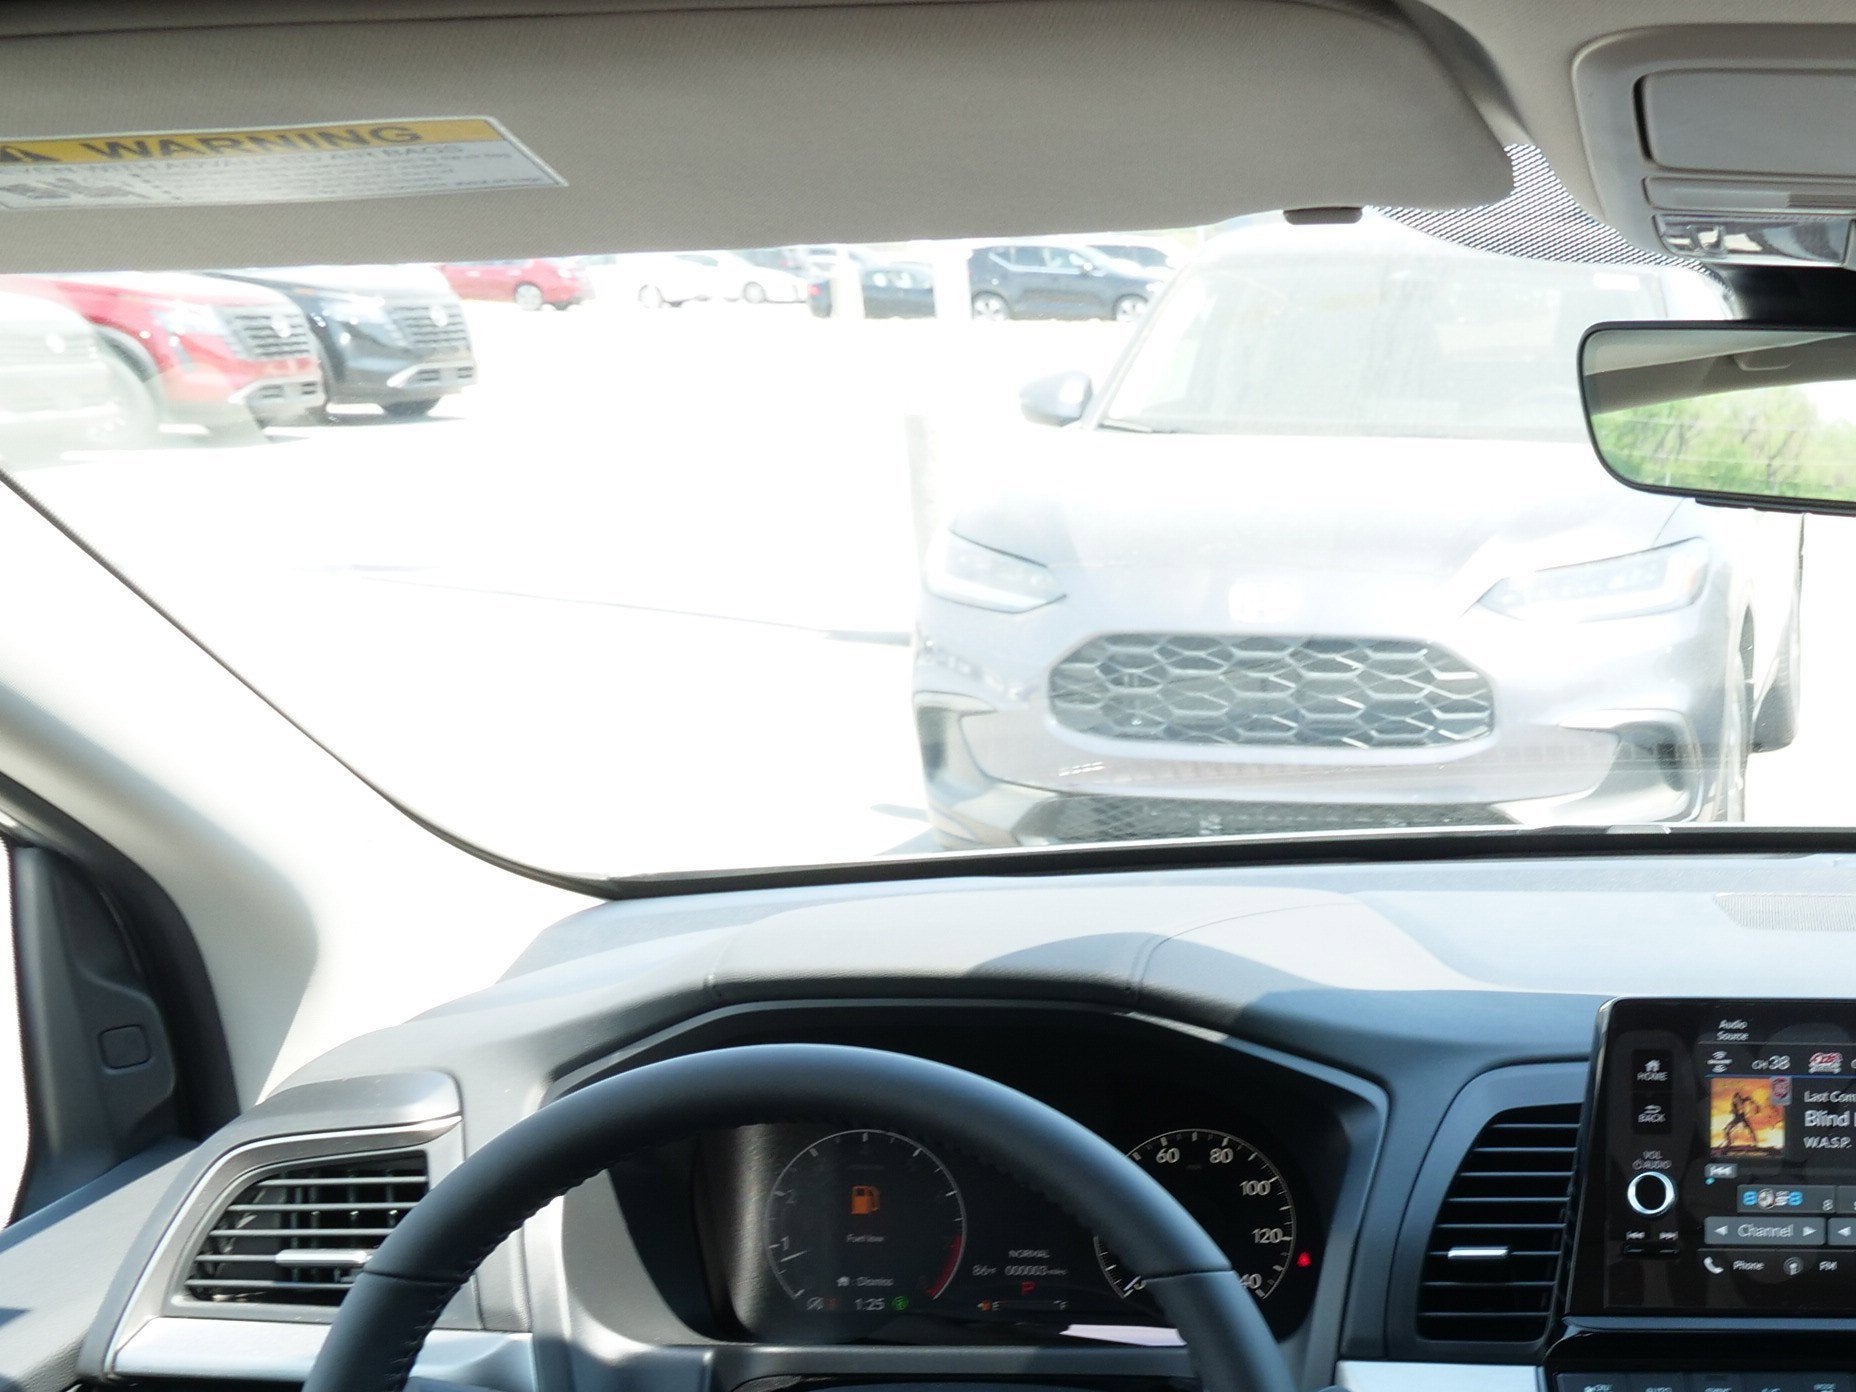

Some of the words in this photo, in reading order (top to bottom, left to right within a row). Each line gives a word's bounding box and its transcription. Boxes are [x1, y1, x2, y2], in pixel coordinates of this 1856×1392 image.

[79, 126, 422, 158] WARNING
[1718, 1019, 1748, 1030] Audio
[1716, 1031, 1749, 1041] Source
[1636, 1071, 1669, 1082] HOME
[1804, 1090, 1829, 1103] Last
[1637, 1112, 1667, 1123] BACK
[1804, 1109, 1850, 1127] Blind
[1156, 1147, 1181, 1163] 60
[1209, 1147, 1234, 1164] 80
[1239, 1180, 1271, 1196] 100
[1822, 1199, 1834, 1211] 8
[1251, 1227, 1284, 1244] 120
[1737, 1223, 1794, 1238] Channel
[1008, 1249, 1051, 1259] NORMAL
[1732, 1260, 1766, 1271] Phone
[1819, 1261, 1838, 1271] FM
[1020, 1280, 1038, 1296] P
[855, 1297, 886, 1311] 1:25
